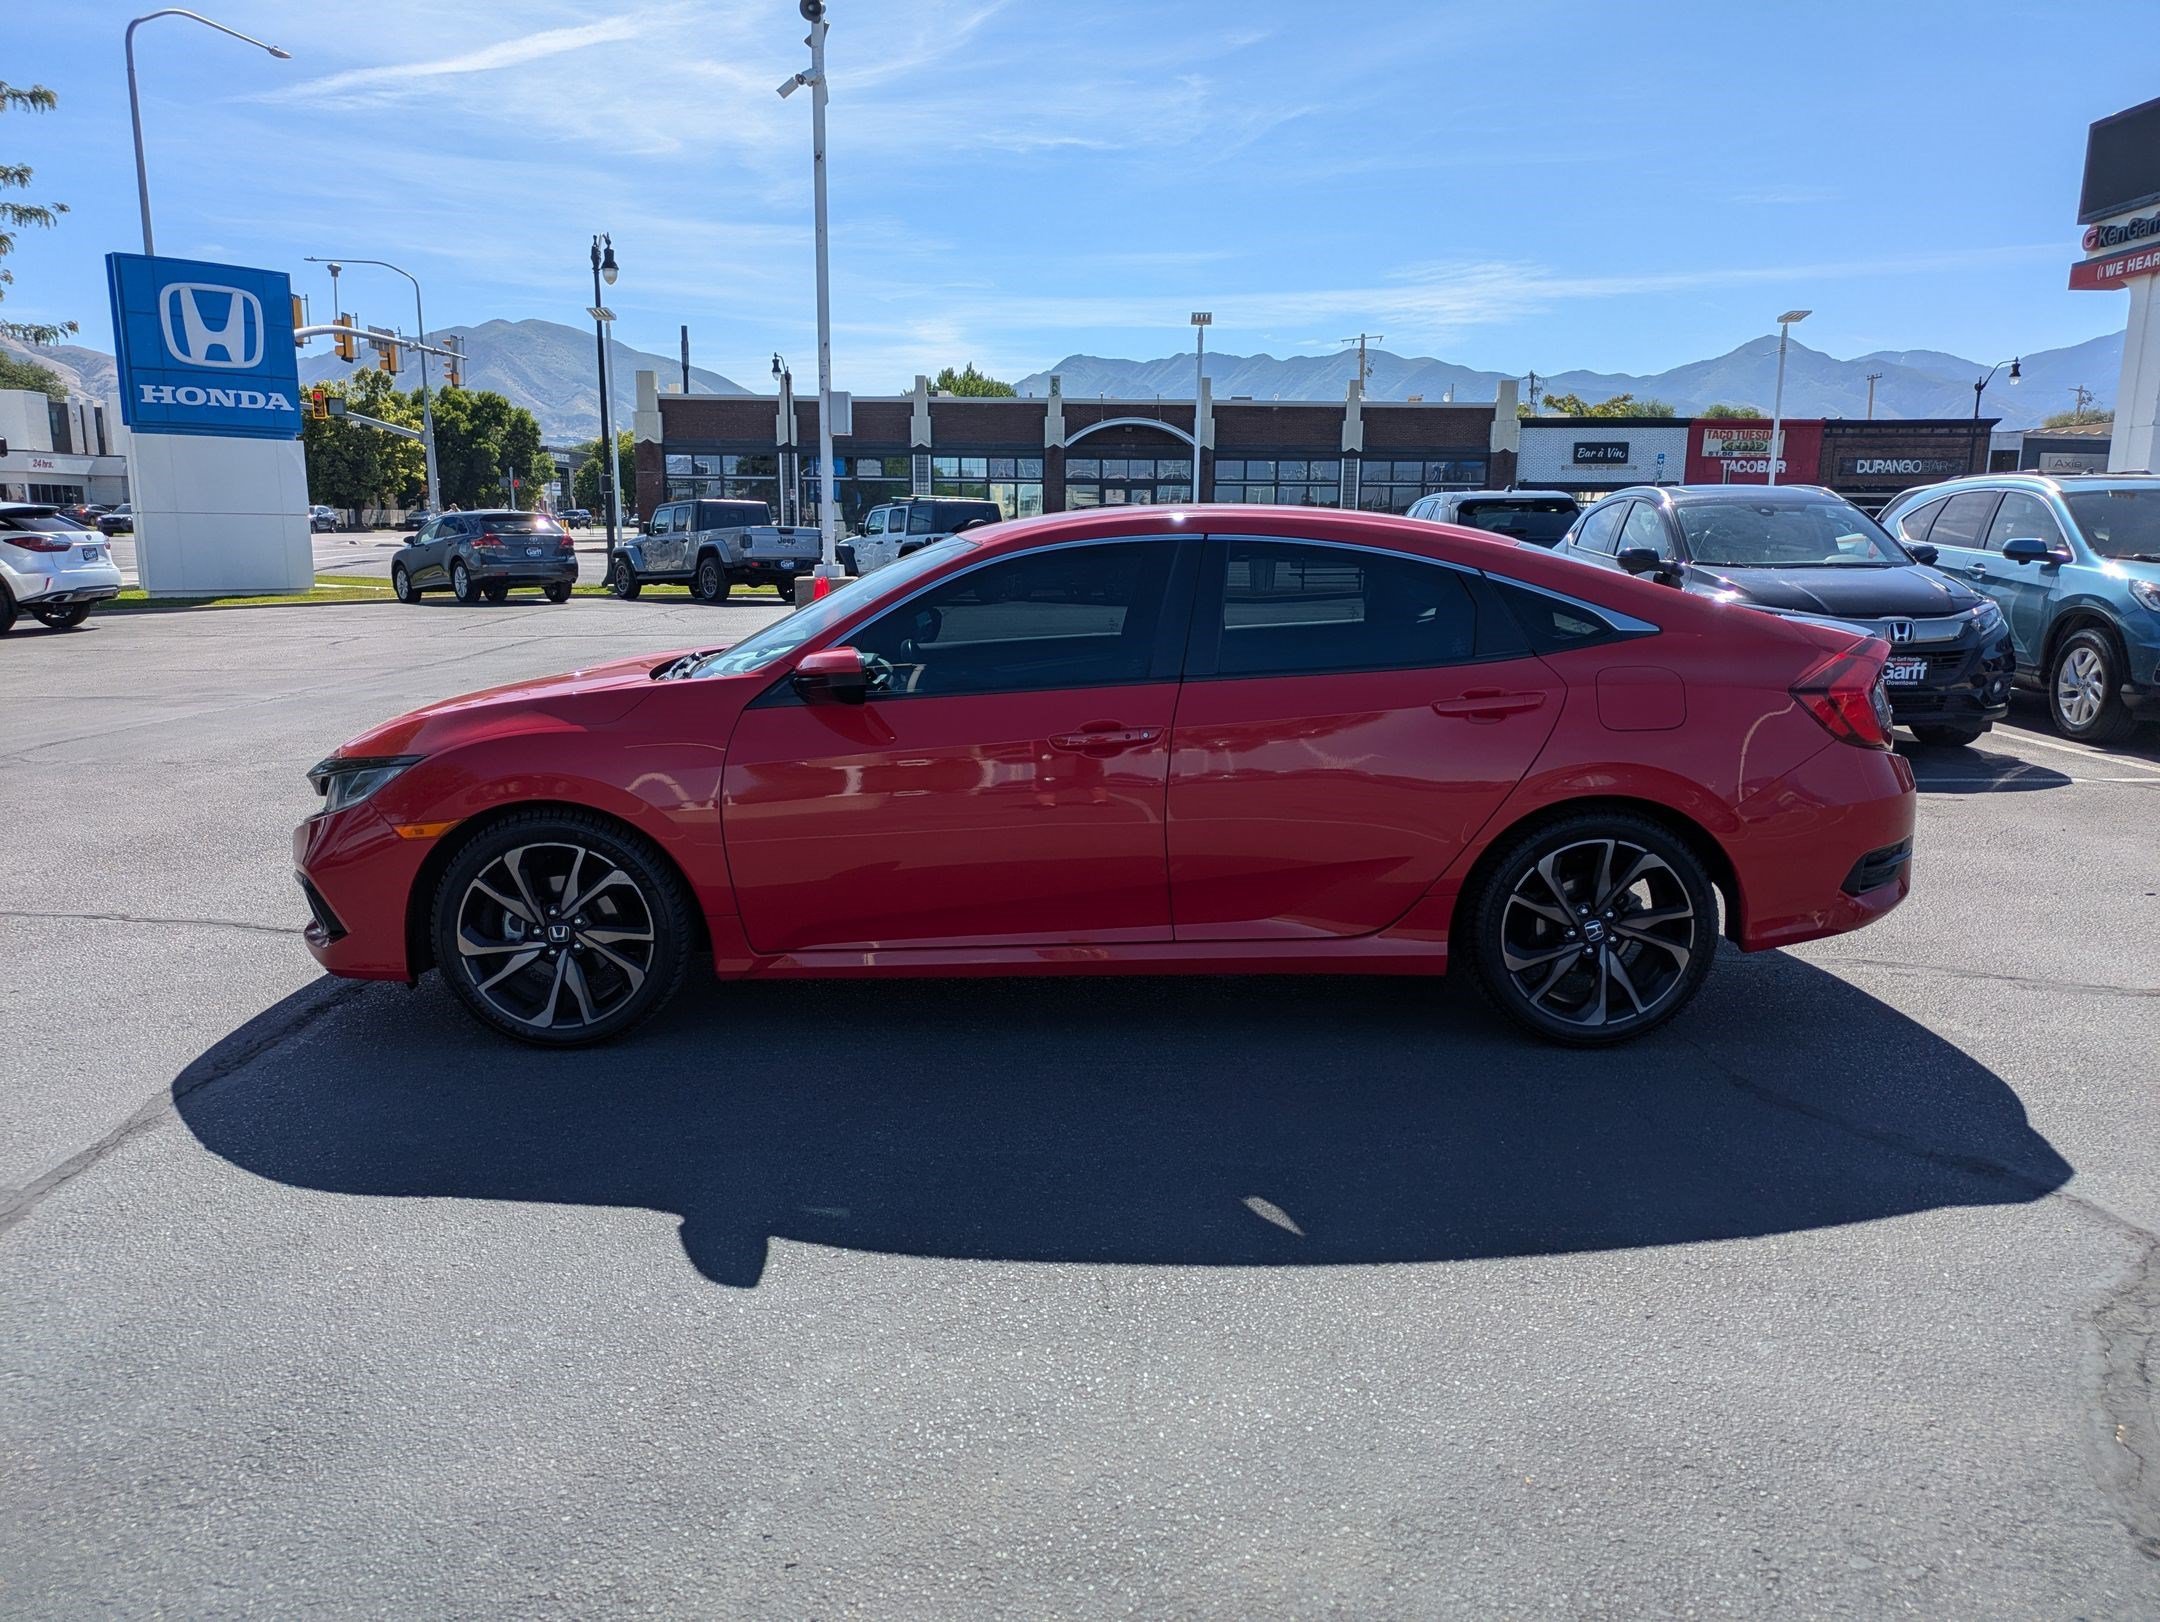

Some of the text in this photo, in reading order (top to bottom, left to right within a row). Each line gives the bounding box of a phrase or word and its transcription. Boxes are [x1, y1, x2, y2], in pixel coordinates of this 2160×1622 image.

[2105, 252, 2160, 278] WE HEAR
[139, 384, 295, 411] HONDA
[1706, 430, 1733, 440] TACO
[1577, 447, 1596, 458] Bar
[1607, 447, 1626, 458] Vin
[32, 459, 54, 469] 24 hrs.
[777, 536, 796, 546] Jeep
[1881, 662, 1927, 679] Garff
